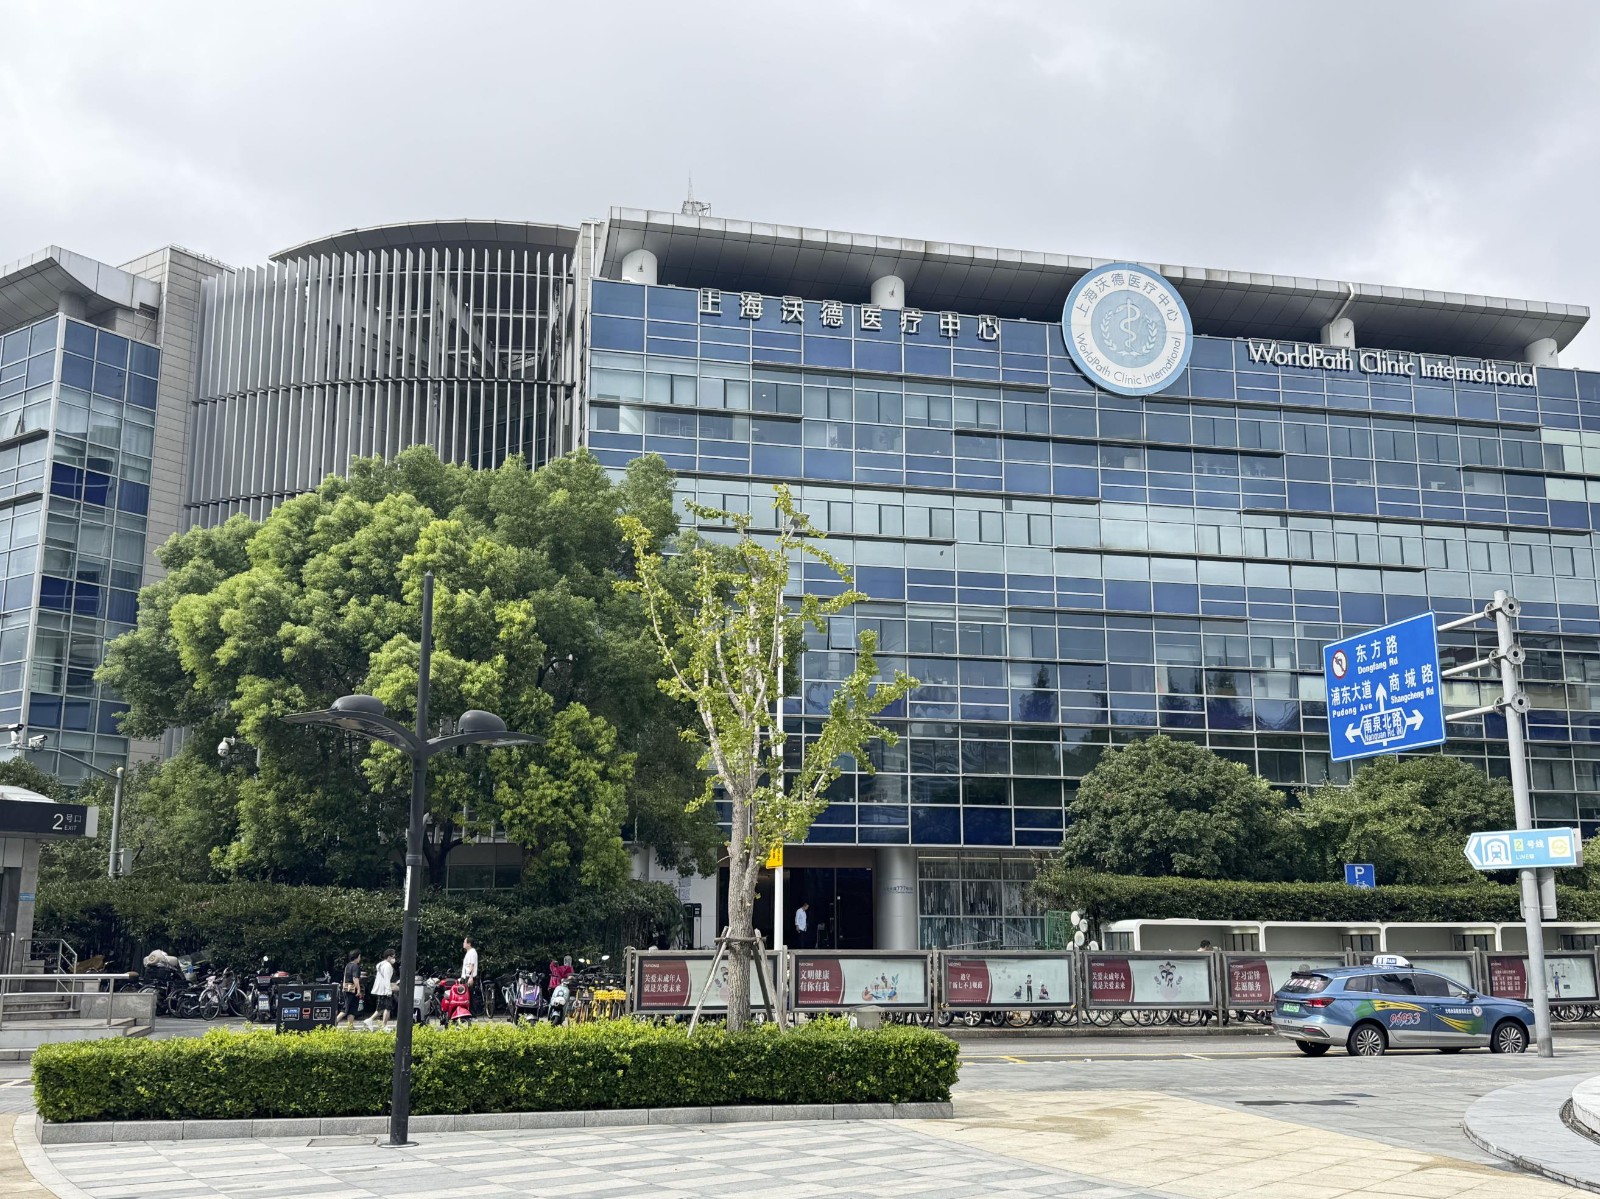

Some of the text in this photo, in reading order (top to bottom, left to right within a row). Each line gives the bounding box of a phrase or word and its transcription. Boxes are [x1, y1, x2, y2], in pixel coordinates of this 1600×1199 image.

[1076, 272, 1178, 322] 上海沃德医疗中心
[699, 289, 1000, 341] 上海沃德医疗中心
[1076, 332, 1182, 385] WorldPath Clinic International
[1248, 340, 1538, 387] WorldPath Clinic International
[1356, 635, 1398, 663] 东方路
[1357, 657, 1399, 675] Dongfang Rd
[1389, 664, 1434, 693] 商城路
[1331, 680, 1373, 707] 浦东大道
[1390, 686, 1435, 704] Shangcheng Rd
[1332, 703, 1373, 719] Pudong Ave
[1363, 711, 1402, 734] 南泉北路
[52, 813, 82, 830] 2 号口
[1354, 866, 1365, 880] P
[644, 973, 682, 983] 关爱未成年人
[800, 969, 830, 980] 文明健康
[1092, 972, 1126, 981] 关爱未成年人
[643, 983, 682, 993] 就是关爱未来
[800, 981, 830, 992] 有你有我
[1389, 1011, 1421, 1028] 96933
